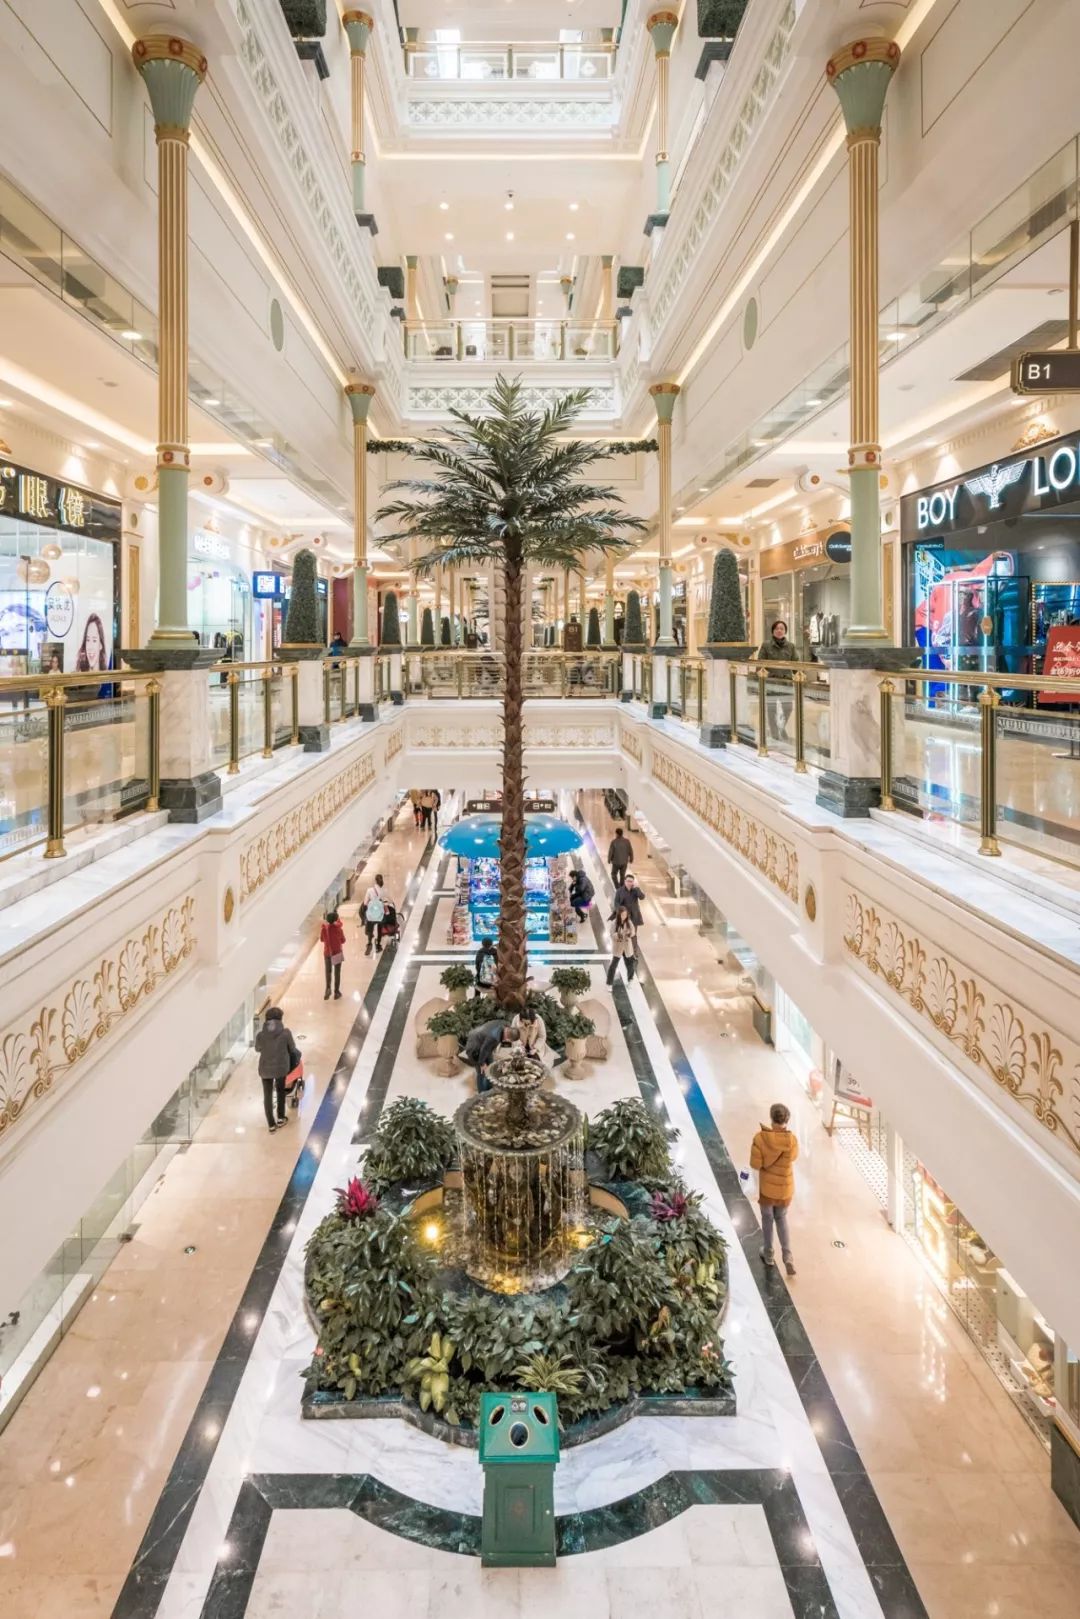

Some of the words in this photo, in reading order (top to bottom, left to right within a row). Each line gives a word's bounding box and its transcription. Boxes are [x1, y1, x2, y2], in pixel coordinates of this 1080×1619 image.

[1028, 364, 1051, 380] B1
[917, 484, 960, 529] BOY
[1033, 442, 1080, 496] LO
